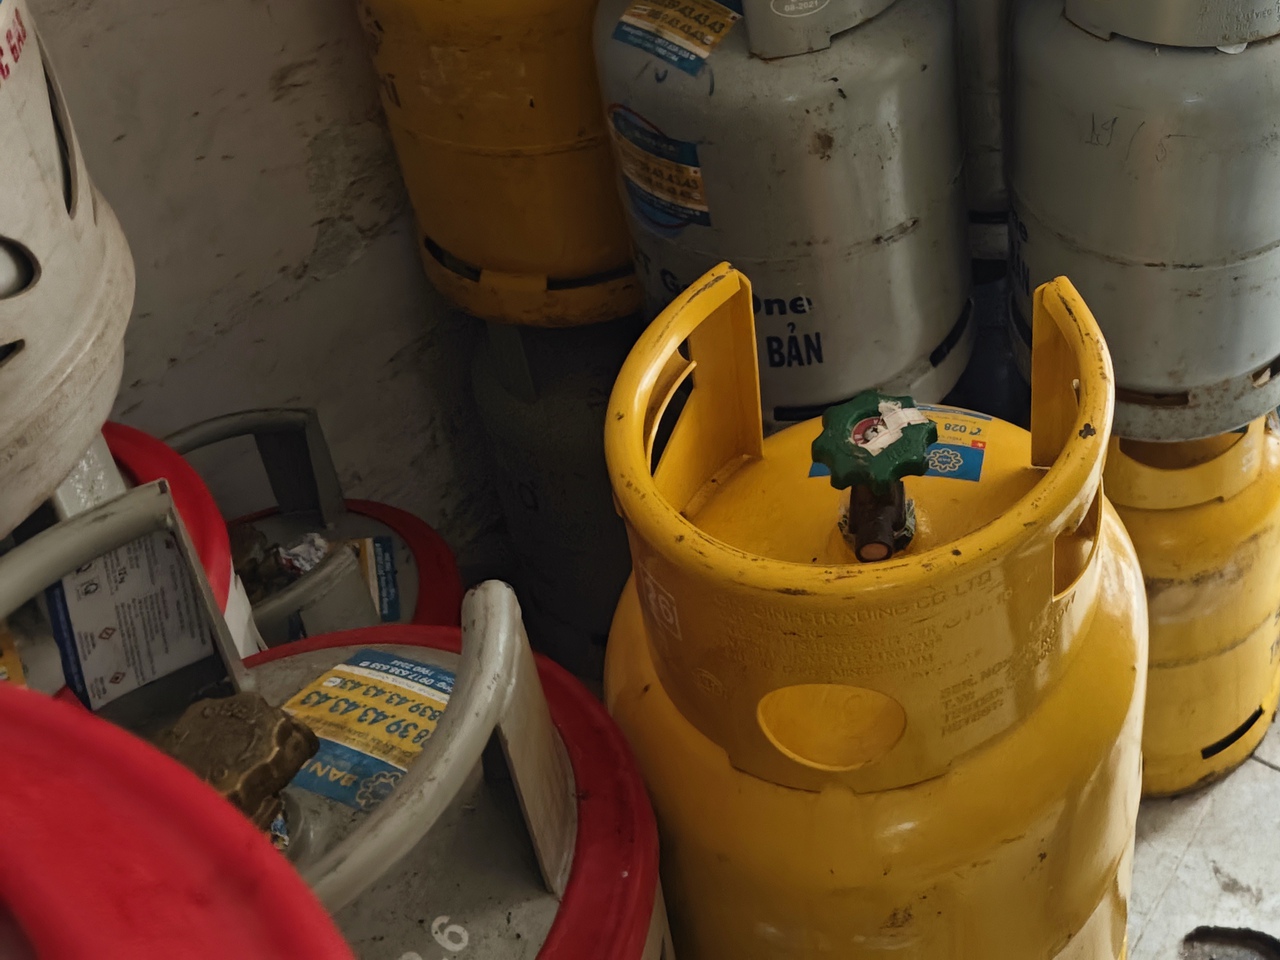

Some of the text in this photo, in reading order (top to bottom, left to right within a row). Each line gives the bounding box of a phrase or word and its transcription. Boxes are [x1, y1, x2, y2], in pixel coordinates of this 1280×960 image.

[766, 322, 824, 368] BẢN
[944, 423, 967, 433] 028
[338, 677, 445, 722] 839.43.43.43
